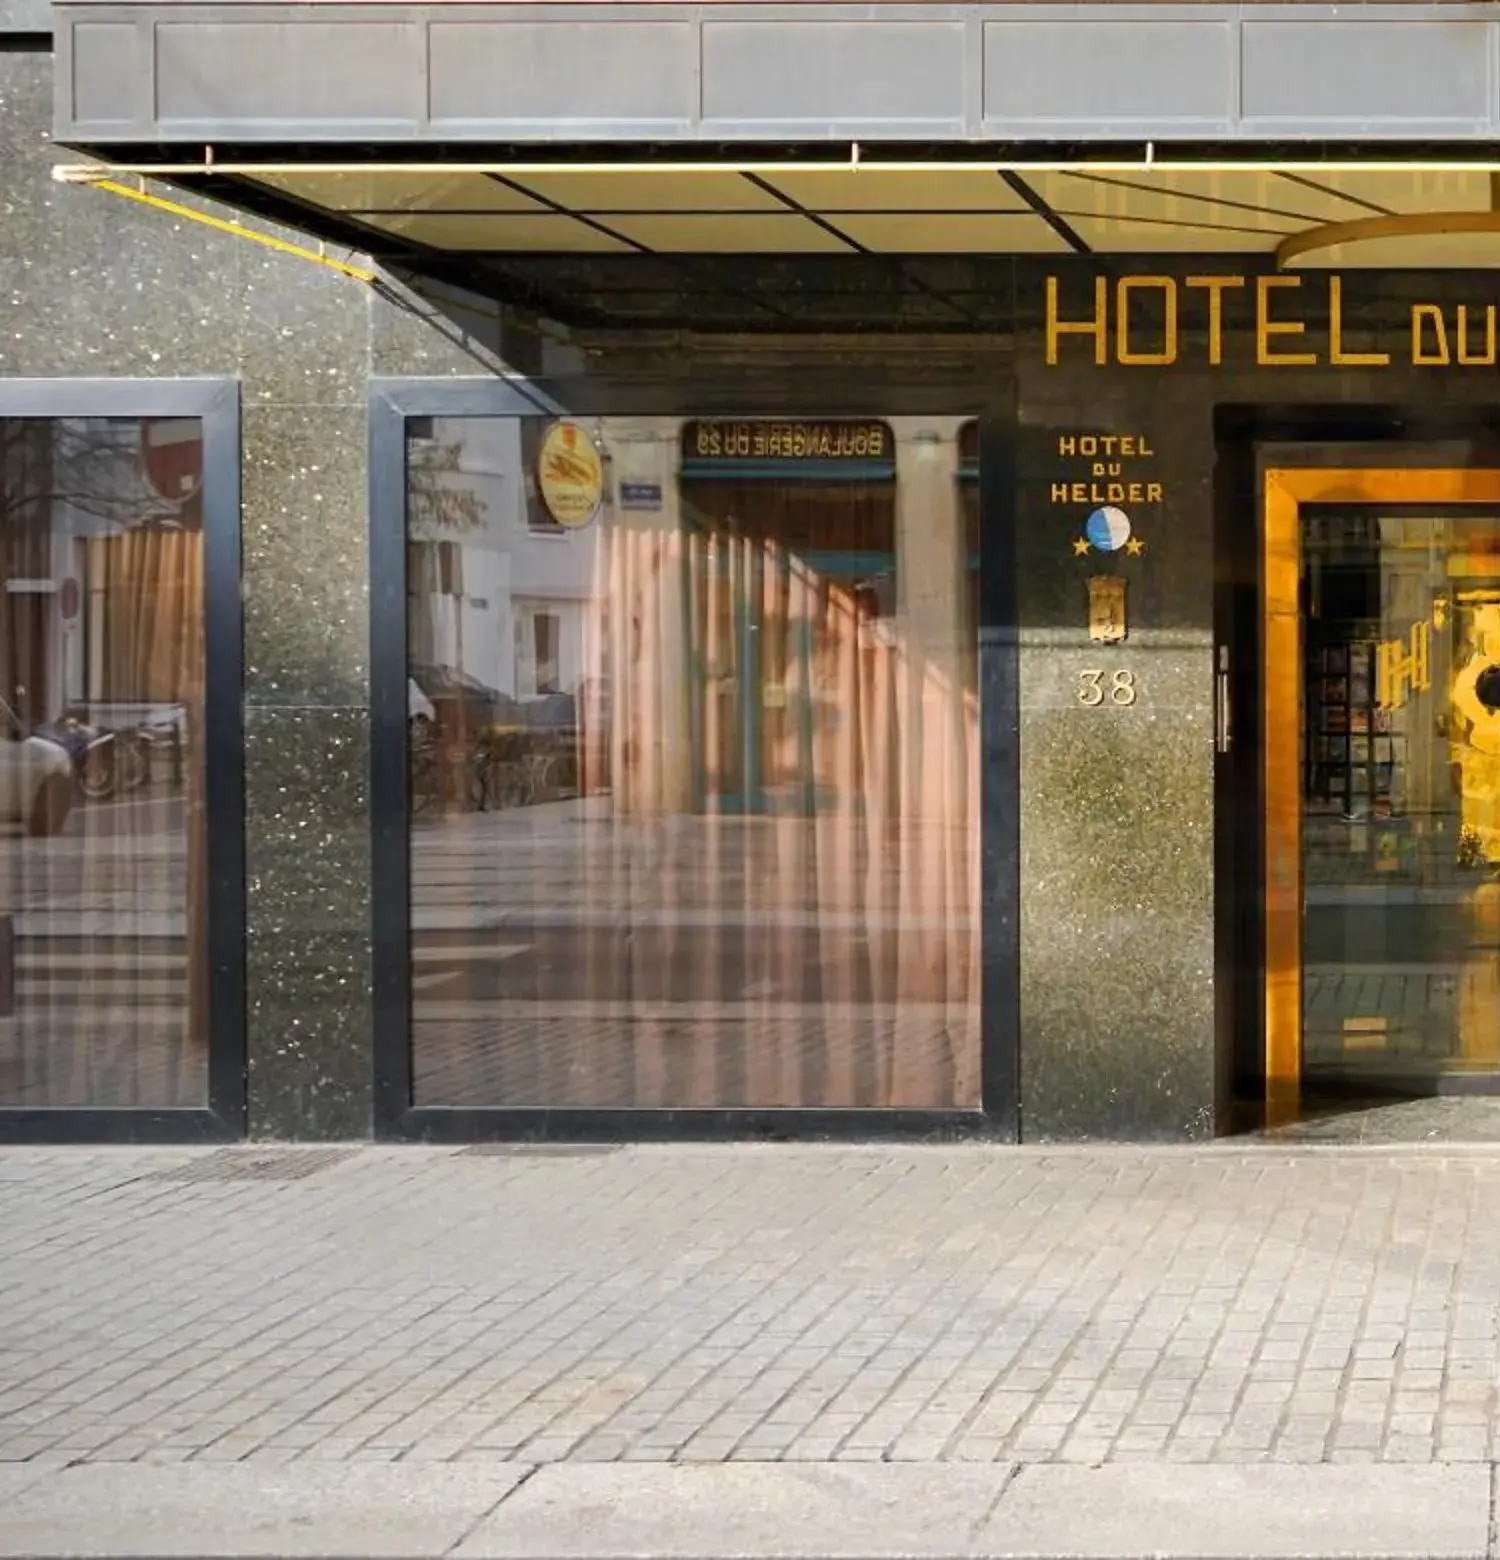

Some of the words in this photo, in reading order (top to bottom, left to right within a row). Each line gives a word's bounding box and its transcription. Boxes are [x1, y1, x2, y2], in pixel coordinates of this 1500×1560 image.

[1046, 275, 1390, 365] HOTEL
[1412, 304, 1496, 365] DU
[1059, 436, 1154, 456] HOTEL
[1092, 462, 1121, 477] DU
[1051, 483, 1163, 503] HELDER
[1076, 668, 1137, 706] 38
